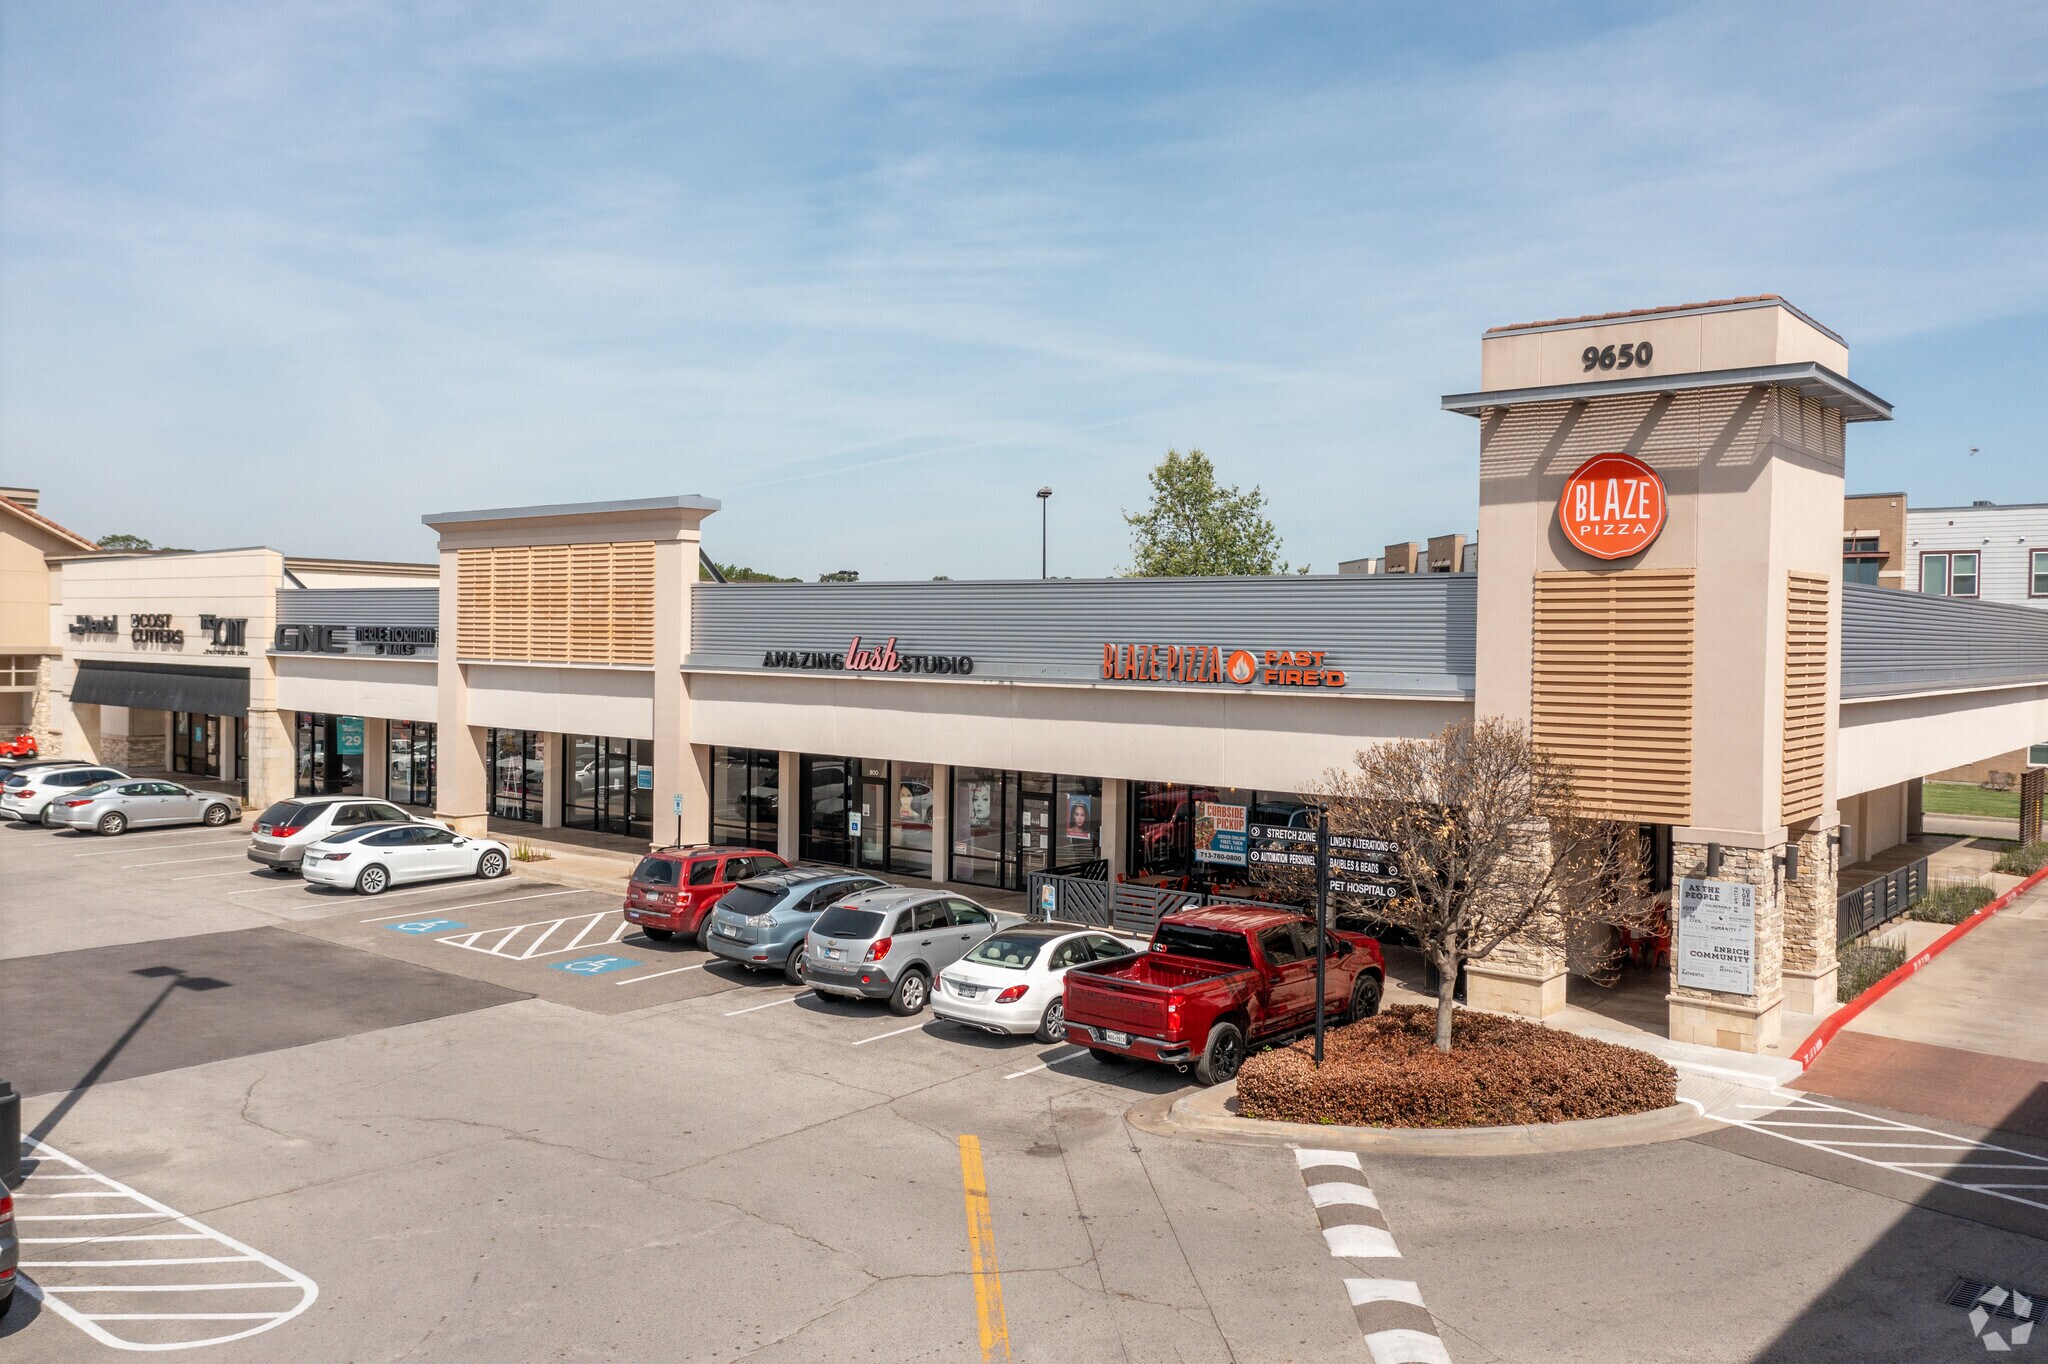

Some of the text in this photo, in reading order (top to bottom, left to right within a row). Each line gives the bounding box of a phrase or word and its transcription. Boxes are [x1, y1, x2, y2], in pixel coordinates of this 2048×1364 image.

[1582, 341, 1653, 372] 9650
[1575, 478, 1650, 522] BLAZE
[1580, 523, 1647, 536] PIZZA
[138, 614, 172, 629] COST
[131, 629, 184, 644] CUTTERS
[274, 624, 347, 653] GNC
[355, 627, 433, 643] MERLE NORMAN
[385, 645, 412, 655] NAILS
[762, 636, 974, 674] AMAZING lash STUDIO
[1103, 643, 1223, 682] BLAZE PIZZA
[1265, 650, 1327, 666] FAST
[1264, 670, 1345, 687] FIRE'D
[1207, 805, 1244, 819] CURBSIDE
[1216, 818, 1244, 831] PICKUP
[1266, 828, 1317, 842] STRETCH ZONE
[1330, 836, 1389, 851] LINDA'S ALTERATIONS
[1200, 851, 1242, 862] 713-780-0800
[1260, 851, 1316, 866] AUTOMATION PERSONNEL
[1329, 857, 1379, 874] BAUBLES & BEADS
[1330, 881, 1386, 897] PET HOSPITAL
[1685, 891, 1720, 901] PEOPLE
[1701, 885, 1720, 894] THE
[1689, 950, 1750, 963] COMMUNITY
[1713, 945, 1750, 956] ENRICH
